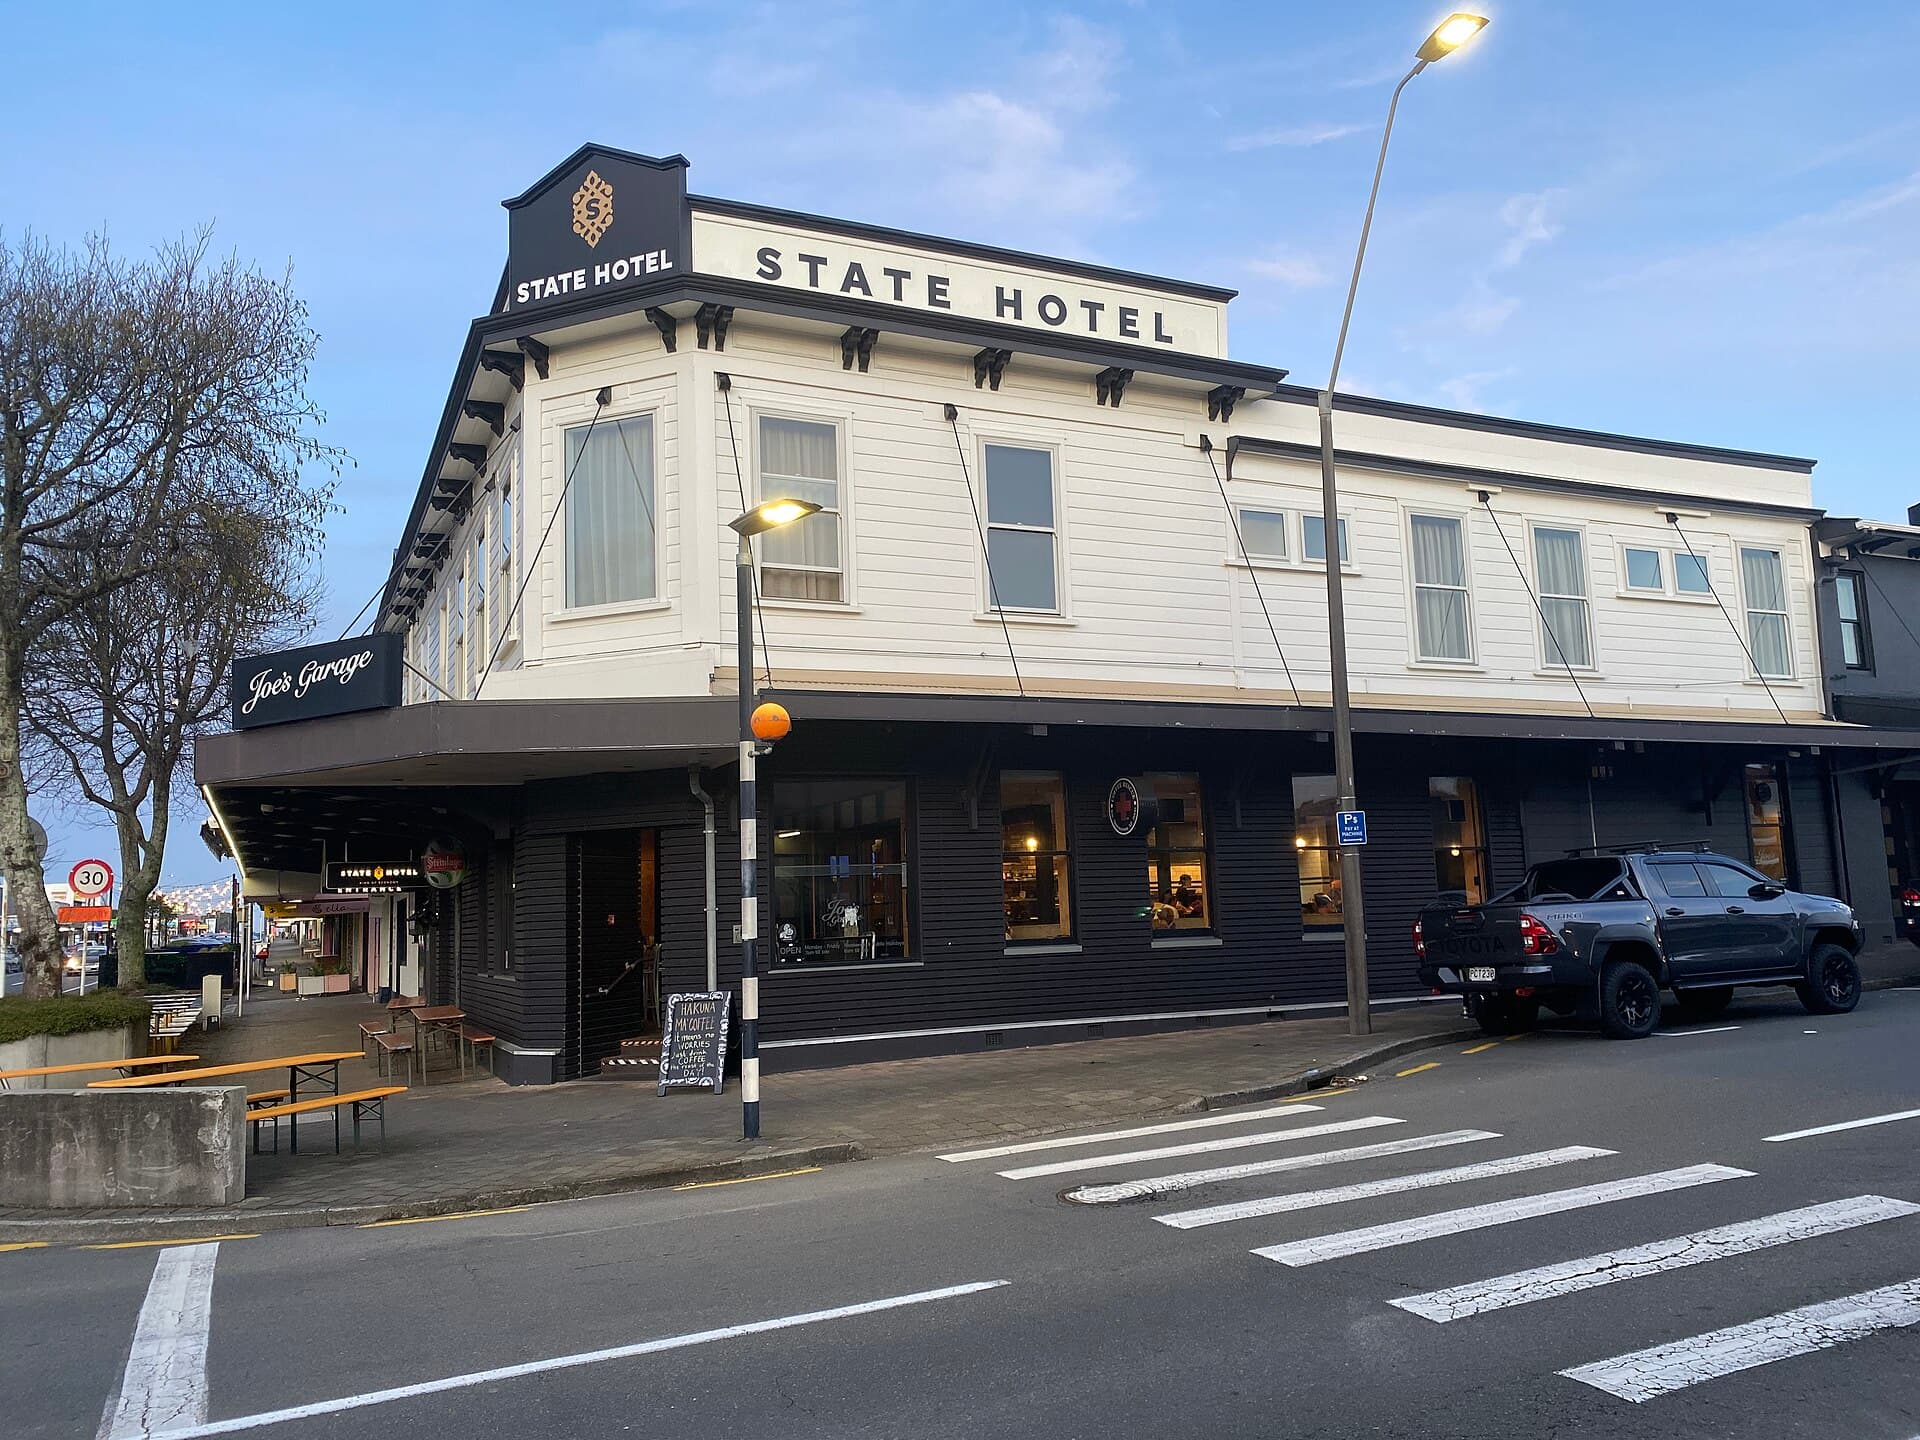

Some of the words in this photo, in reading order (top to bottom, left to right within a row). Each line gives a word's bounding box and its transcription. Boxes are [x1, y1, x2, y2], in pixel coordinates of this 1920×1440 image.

[585, 197, 601, 220] S
[516, 268, 587, 304] STATE
[593, 249, 674, 286] HOTEL
[755, 246, 952, 310] STATE
[994, 285, 1174, 345] HOTEL
[241, 668, 293, 715] Joe's
[293, 650, 375, 698] Garage
[79, 870, 104, 886] 30
[385, 868, 419, 876] HOTEL
[779, 946, 802, 955] OPEN
[1438, 936, 1506, 953] TOYOTA
[680, 1002, 716, 1016] HAKUNA
[678, 1055, 706, 1066] COFFEE
